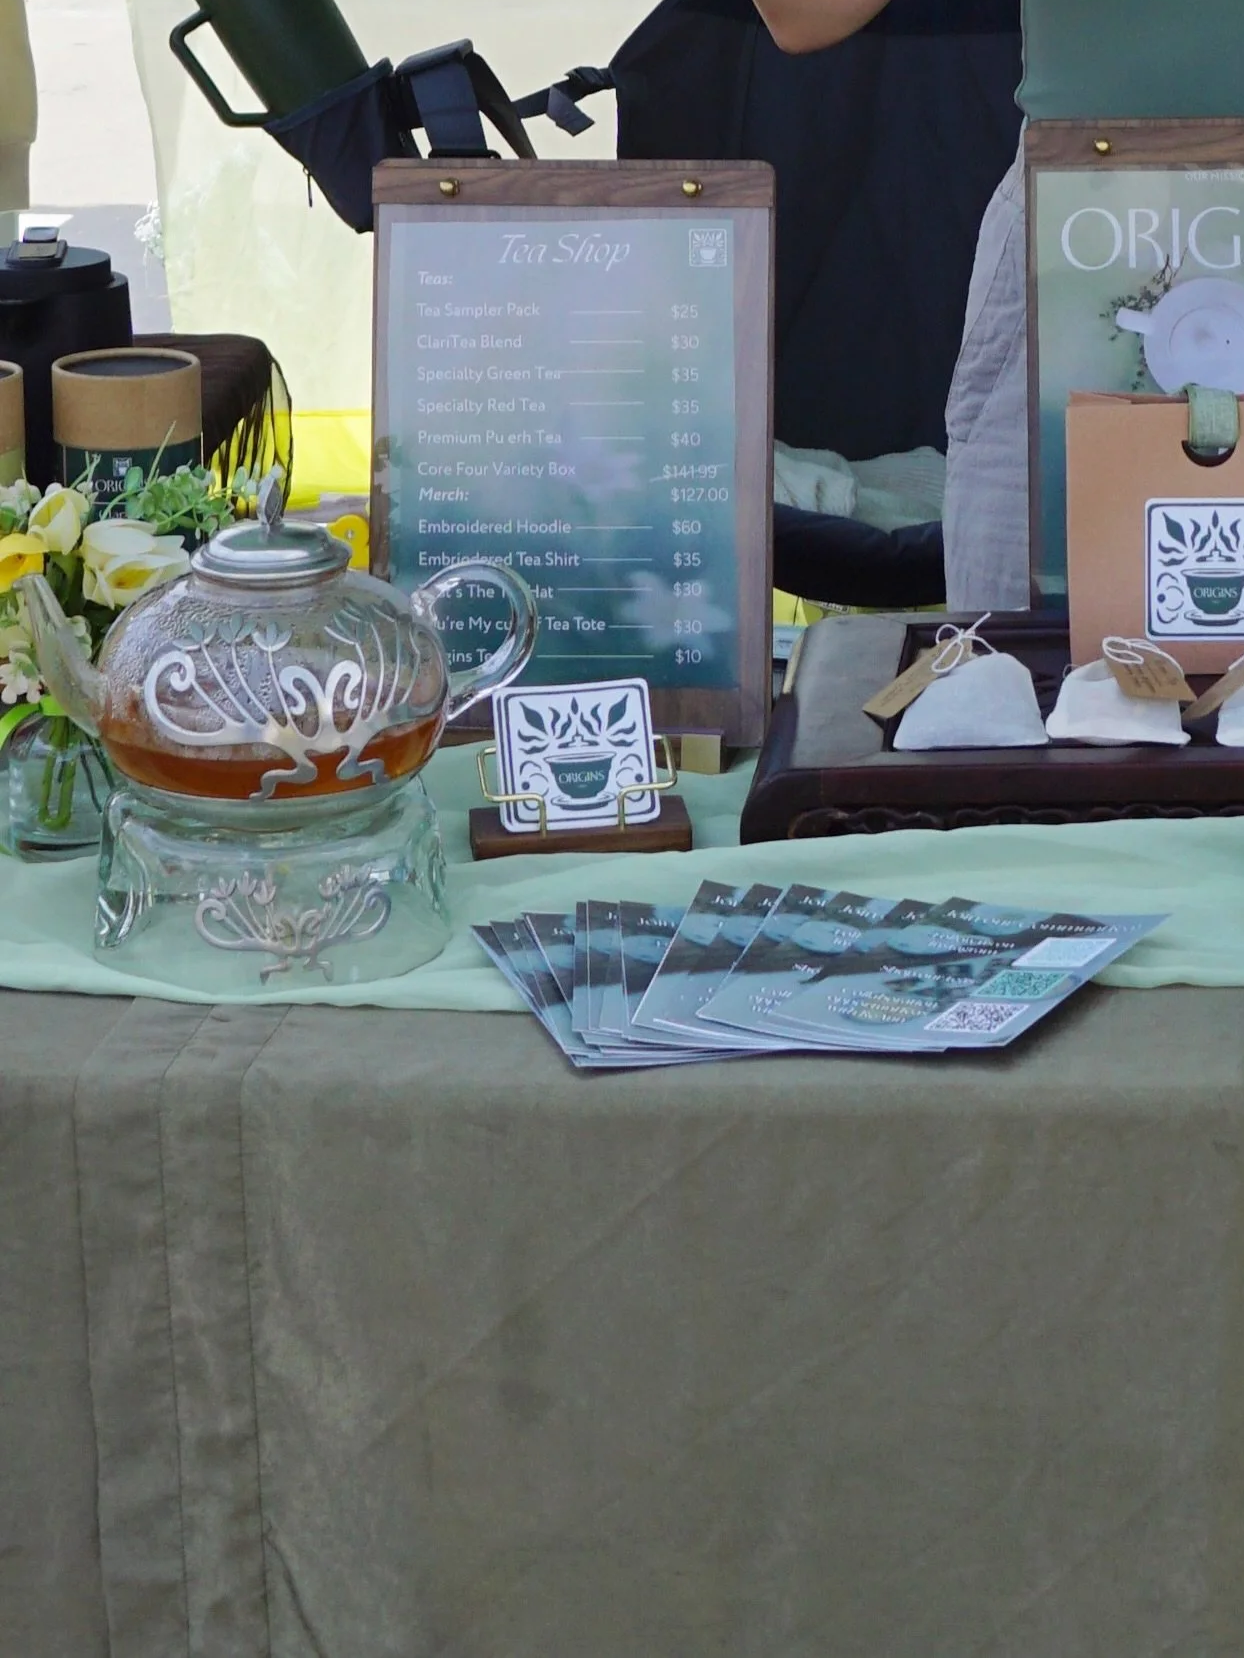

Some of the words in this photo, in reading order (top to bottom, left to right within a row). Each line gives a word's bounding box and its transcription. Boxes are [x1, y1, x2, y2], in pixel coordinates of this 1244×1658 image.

[498, 232, 548, 265] Tea
[552, 232, 631, 272] Shop
[418, 271, 454, 286] Teas:
[416, 302, 441, 317] Tea
[444, 303, 503, 319] Sampler
[507, 302, 541, 317] Pack
[671, 304, 699, 320] $25
[417, 334, 477, 350] ClariTea
[481, 334, 523, 349] Blend
[671, 335, 700, 351] $30
[417, 366, 483, 384] Specialty
[486, 366, 531, 381] Green
[534, 366, 561, 381] Tea
[671, 367, 700, 383] $35
[417, 398, 484, 415] Specialty
[487, 398, 516, 413] Red
[520, 398, 546, 413] Tea
[671, 399, 700, 415] $35
[417, 430, 482, 445] Premium
[535, 429, 562, 445] Tea
[671, 432, 701, 448] $40
[417, 462, 453, 477] Core
[456, 462, 490, 477] Four
[492, 462, 545, 478] Variety
[549, 462, 576, 477] Box
[418, 487, 470, 503] Merch:
[671, 487, 729, 503] $127.00
[418, 518, 513, 534] Embroidered
[516, 518, 572, 534] Hoodie
[672, 519, 702, 535] $60
[516, 550, 542, 567] Tea
[544, 550, 581, 567] Shirt
[673, 551, 701, 568] $35
[465, 583, 495, 599] The
[673, 582, 702, 598] $30
[1193, 586, 1239, 599] ORIGINS
[468, 615, 493, 634] My
[545, 615, 570, 631] Tea
[573, 616, 606, 631] Tote
[673, 619, 702, 635] $30
[675, 648, 702, 664] $10
[558, 769, 606, 785] ORIGINS
